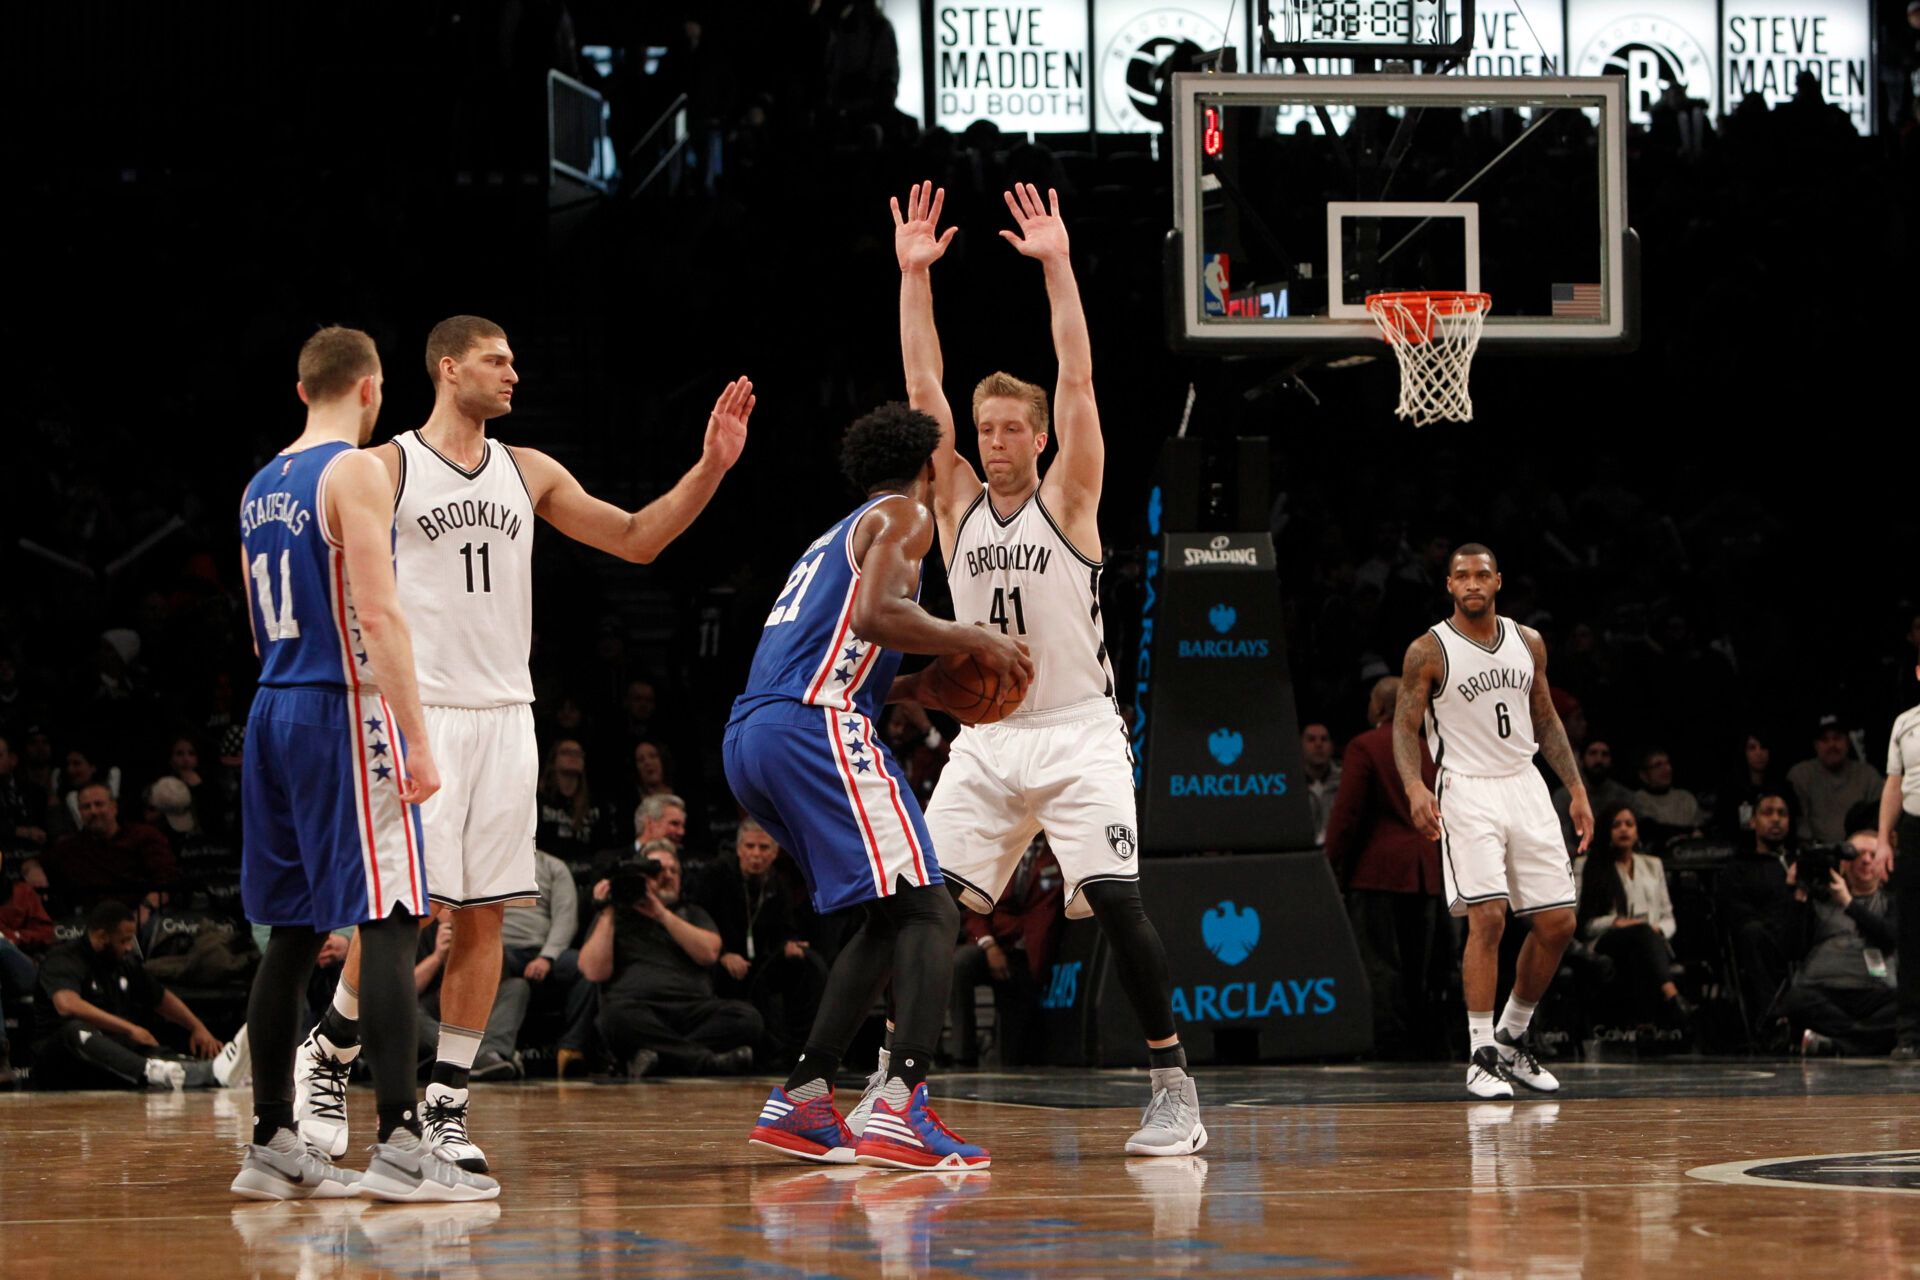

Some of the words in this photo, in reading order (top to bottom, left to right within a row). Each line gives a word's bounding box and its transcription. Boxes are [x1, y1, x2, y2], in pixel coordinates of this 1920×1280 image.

[941, 8, 1044, 46] STEVE
[1729, 16, 1828, 54] STEVE
[941, 51, 1083, 89] MADDEN
[941, 93, 975, 116] DJ
[986, 93, 1085, 116] BOOTH
[417, 500, 522, 541] BROOKLYN
[459, 542, 491, 594] 11
[967, 543, 1052, 578] BROOKLYN
[1183, 547, 1258, 567] SPALDING
[251, 549, 300, 642] 11
[764, 552, 826, 628] 21
[989, 586, 1027, 635] 41
[1178, 639, 1269, 657] BARCLAYS
[1457, 667, 1532, 703] BROOKLYN
[1495, 702, 1512, 739] 6
[1170, 773, 1288, 796] BARCLAYS
[1108, 825, 1136, 845] NETS
[1171, 977, 1337, 1022] ARCLAYS
